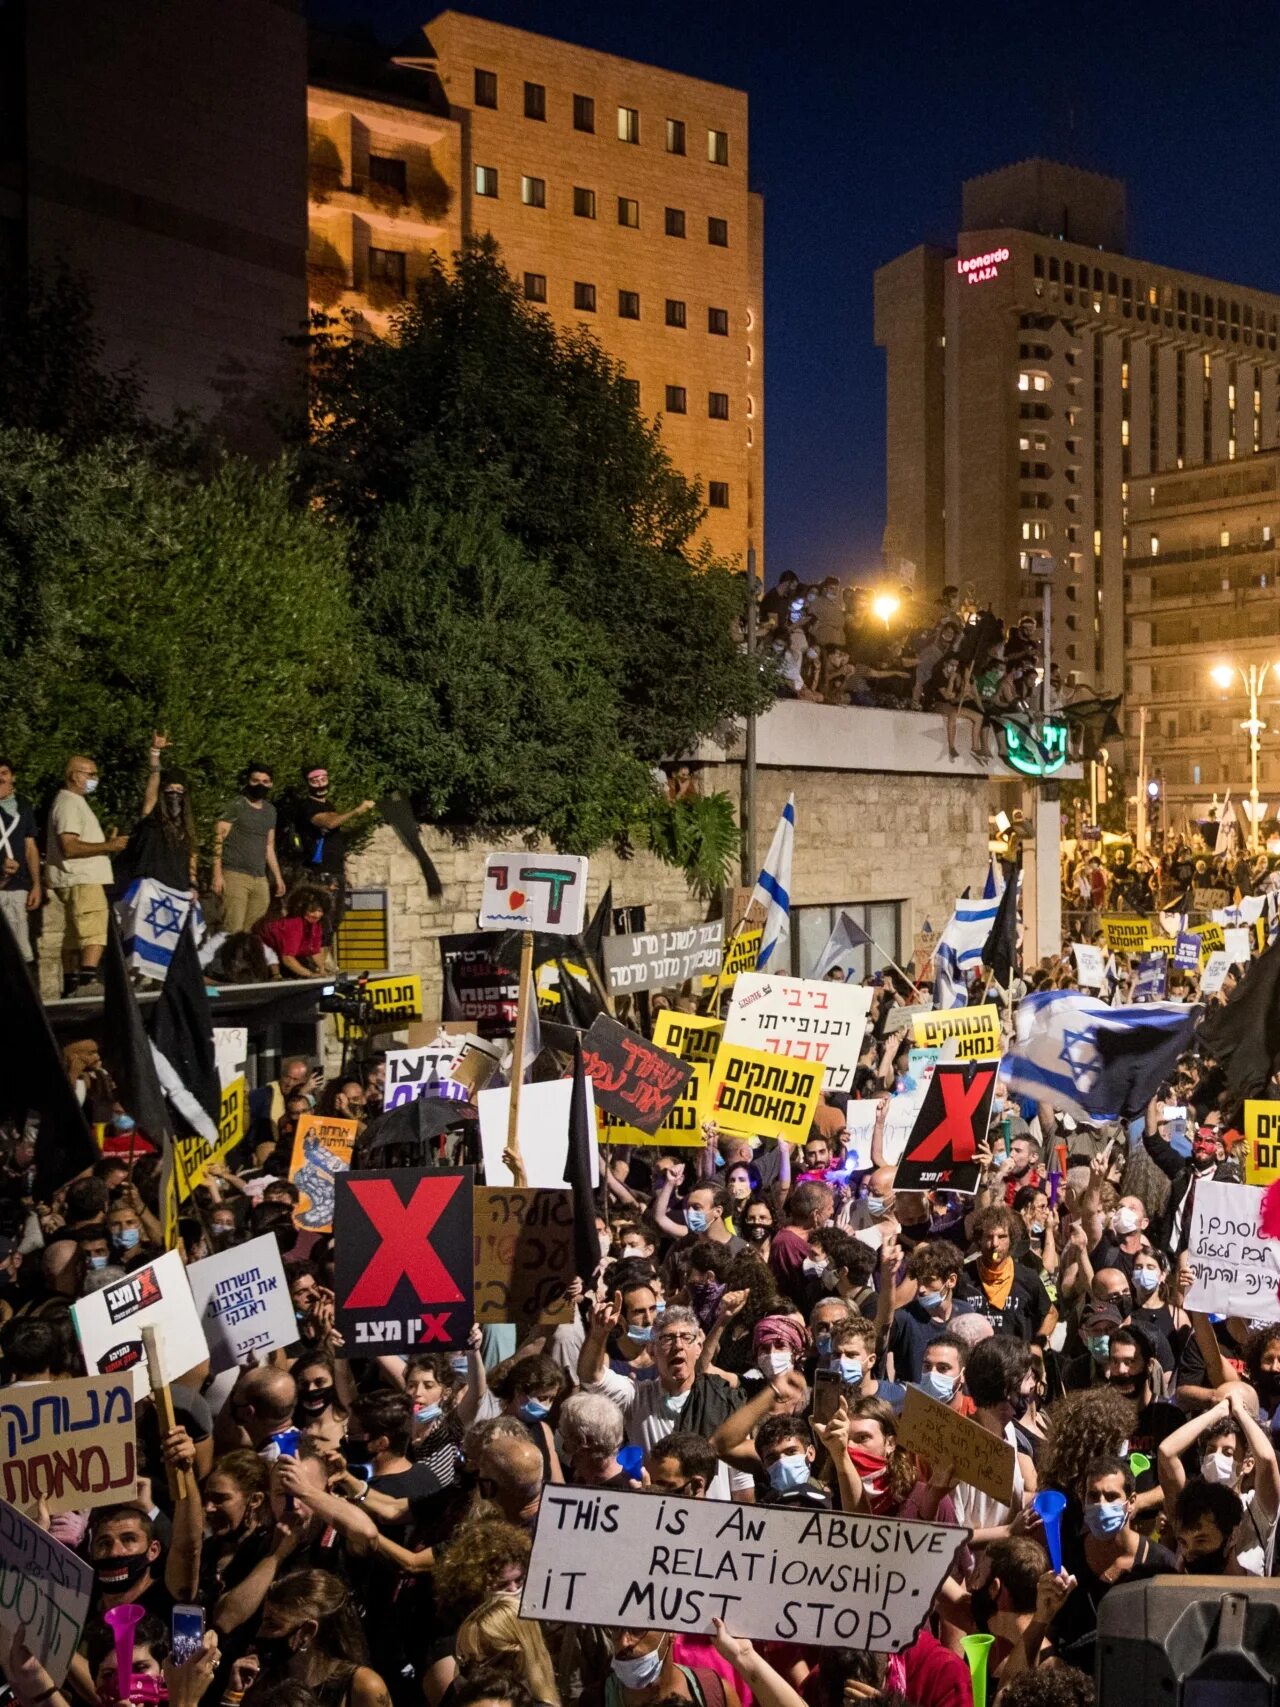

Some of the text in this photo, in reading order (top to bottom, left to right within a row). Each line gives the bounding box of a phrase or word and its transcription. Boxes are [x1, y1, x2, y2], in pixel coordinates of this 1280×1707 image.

[957, 248, 1010, 274] Leonardo
[968, 266, 998, 284] PLAZA
[1110, 935, 1148, 947] מאסתם
[610, 963, 647, 987] מרמה
[783, 988, 828, 1009] ביבי
[759, 1014, 851, 1036] וכנופייתו
[924, 1014, 993, 1040] מנותקים
[726, 1057, 815, 1098] מנותקים
[713, 1082, 807, 1126] נמאסתם!
[215, 1267, 262, 1296] תשרתו
[257, 1276, 278, 1296] את
[237, 1331, 270, 1351] דרכנו
[355, 1319, 402, 1344] מצב
[0, 1385, 132, 1457] מנותק
[715, 1506, 766, 1542] AN
[618, 1580, 742, 1625] MUST
[775, 1601, 901, 1651] STOP.
